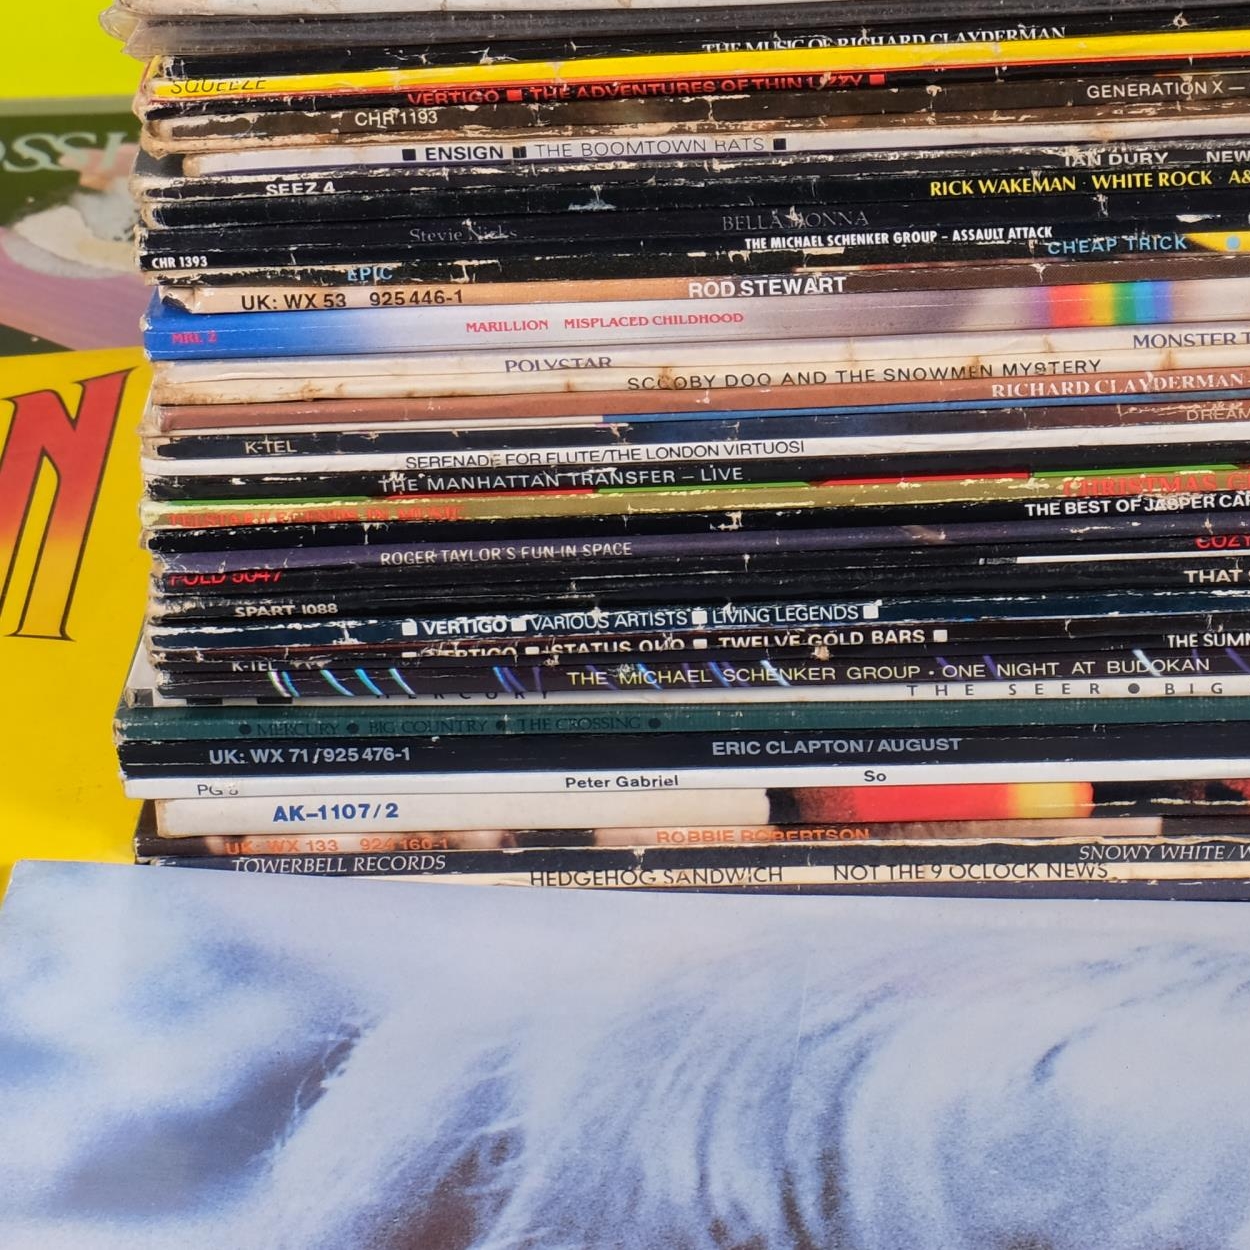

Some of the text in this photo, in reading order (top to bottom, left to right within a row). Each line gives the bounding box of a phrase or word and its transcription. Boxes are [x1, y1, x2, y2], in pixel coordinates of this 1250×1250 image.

[1087, 80, 1208, 99] GENERATION
[1212, 81, 1223, 93] X
[426, 137, 764, 160] ENSIGN THE BOOMTOWN RATS
[746, 224, 1054, 250] THE MICHAEL SCHENKER GROUP ASSAULT ATTACK
[151, 254, 208, 269] CHR 1393
[348, 268, 393, 281] EPIC
[689, 277, 847, 298] ROD STEWART
[466, 313, 744, 332] MARILLION MISPLACED CHILDHOOD
[245, 441, 297, 454] K-TEL
[406, 440, 804, 469] SERENADE FOR FLUTE/THE LONDON VIRTUOSI
[427, 474, 561, 491] MANHATTAN
[568, 470, 675, 486] TRANSFER
[701, 467, 743, 481] LIVE
[1026, 503, 1059, 516] THE
[1065, 501, 1109, 514] BEST
[1116, 498, 1141, 512] OF
[423, 605, 859, 635] VERTIGO VARIOUS ARTISTS LIVING LEGENDS
[1168, 634, 1198, 648] THE
[568, 658, 1209, 686] THE MICHAEL SCHENKER GROUP ONE NIGHT AT BUDOKAN
[908, 684, 974, 697] THE
[1008, 682, 1101, 697] SEER
[1164, 683, 1222, 695] BIG
[565, 770, 886, 790] Peter Gabriel So
[656, 828, 870, 844] ROBBIE ROBERTSON
[232, 855, 446, 874] TOWERBELL RECORDS
